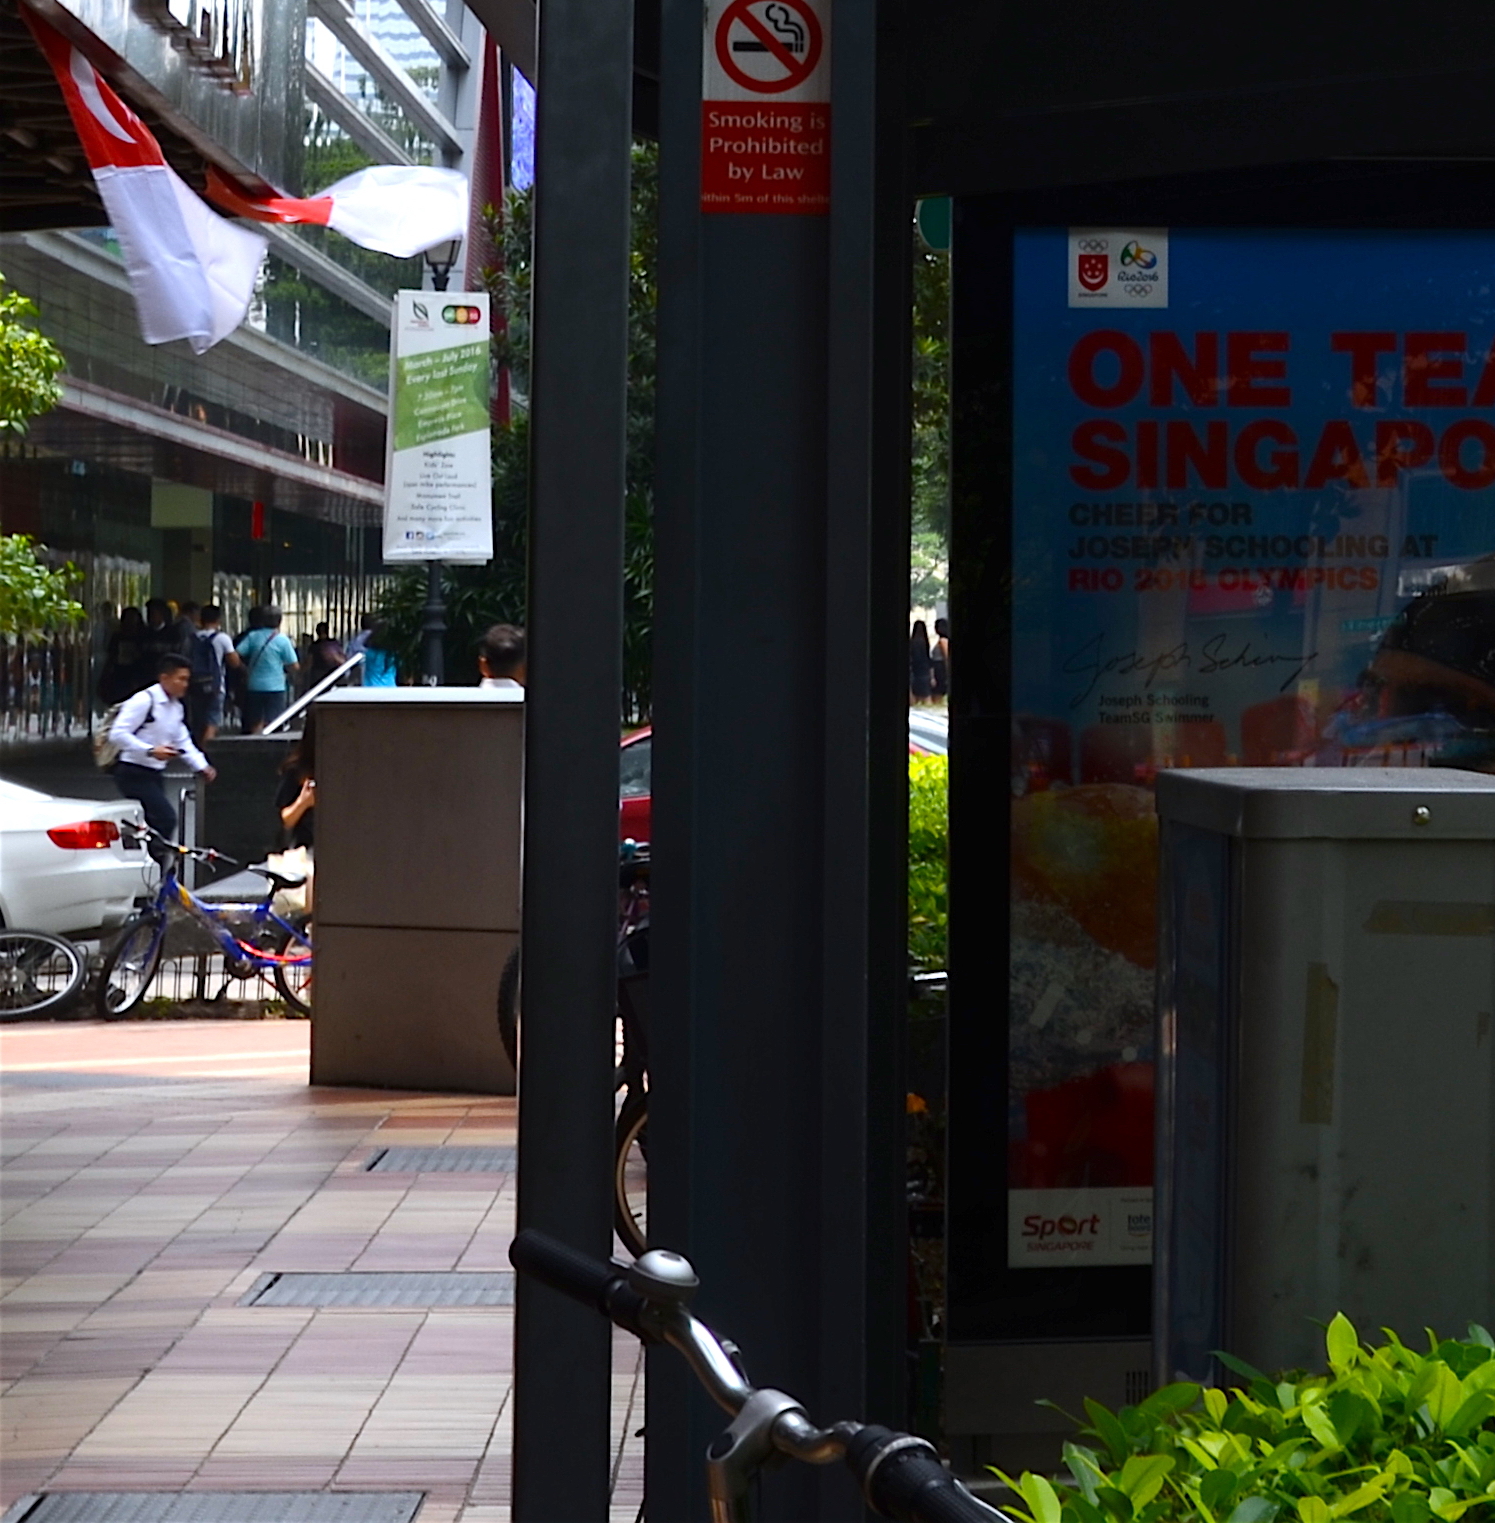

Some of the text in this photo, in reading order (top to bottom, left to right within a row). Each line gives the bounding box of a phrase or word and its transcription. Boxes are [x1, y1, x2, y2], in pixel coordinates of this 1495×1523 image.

[709, 111, 826, 133] Smoking is
[709, 136, 824, 156] Prohibited
[728, 162, 805, 184] by Law
[701, 191, 730, 204] ithin
[734, 192, 754, 204] 5m
[756, 192, 770, 205] of
[772, 192, 795, 205] this
[1067, 329, 1292, 410] ONE
[1068, 502, 1252, 527] CHEER FOR
[1067, 534, 1438, 560] JOSEPH SCHOOLING AT
[1068, 567, 1379, 592] RIO 2016 OLYMPICS
[1098, 694, 1210, 708] Joseph Schooling
[1099, 712, 1215, 724] TeamSG Swimmer
[1022, 1213, 1101, 1240] Sport
[1026, 1241, 1095, 1253] SINGAPORE
